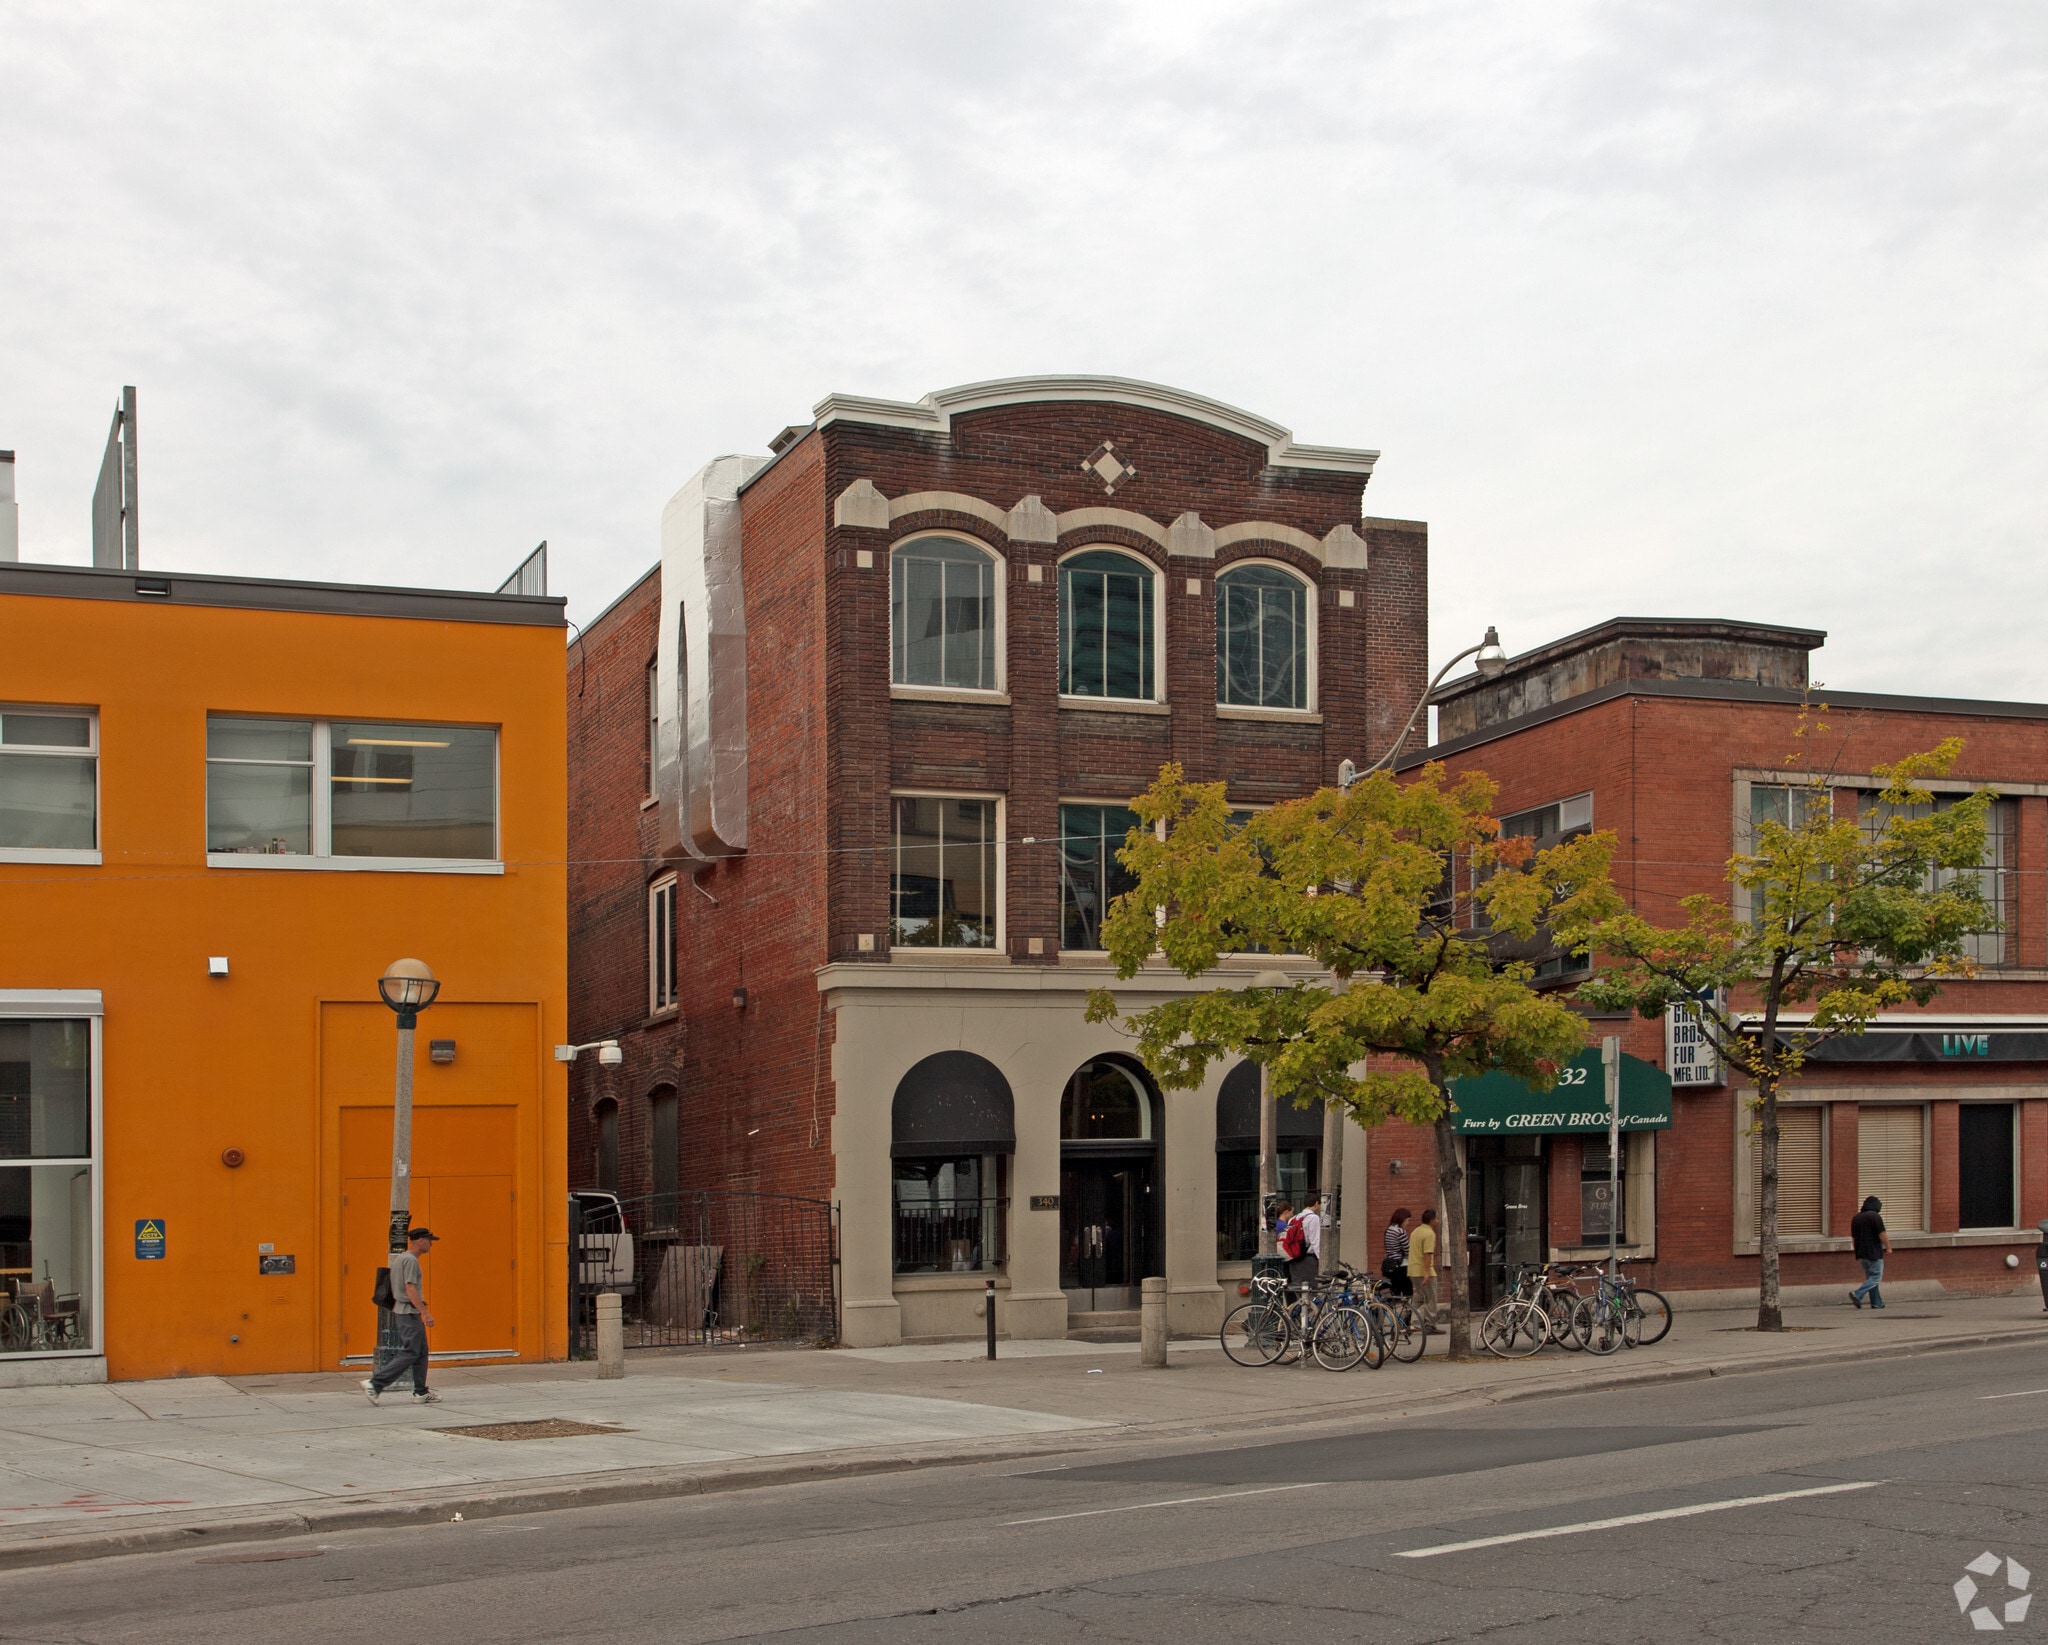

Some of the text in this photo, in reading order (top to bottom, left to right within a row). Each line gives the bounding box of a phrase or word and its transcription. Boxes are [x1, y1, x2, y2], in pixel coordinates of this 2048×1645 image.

[1673, 1004, 1709, 1023] GREN
[1943, 1034, 1988, 1055] LIVE
[1673, 1046, 1695, 1064] FUR
[1554, 1067, 1587, 1086] 32
[1673, 1065, 1710, 1082] MFG. LTD.
[1463, 1118, 1486, 1128] Furs
[1488, 1118, 1501, 1130] by
[1505, 1113, 1566, 1128] GREEN
[1617, 1115, 1628, 1127] of
[1630, 1114, 1668, 1124] Canada
[1037, 1197, 1054, 1206] 340
